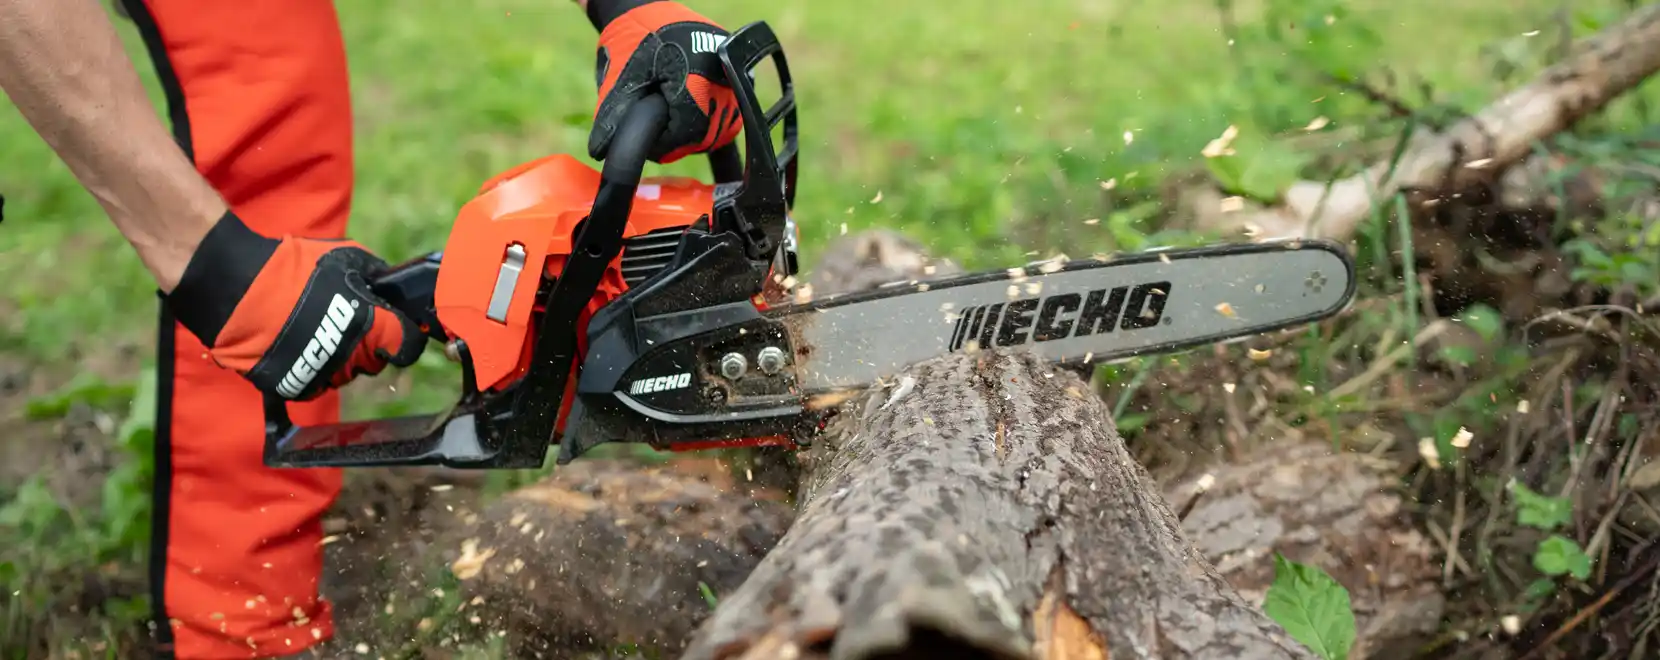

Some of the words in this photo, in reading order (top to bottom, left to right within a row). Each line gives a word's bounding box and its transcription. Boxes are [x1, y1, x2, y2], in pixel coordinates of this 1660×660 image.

[291, 293, 355, 385] ECHO
[996, 281, 1171, 347] ECHO
[643, 373, 691, 393] ECHO
